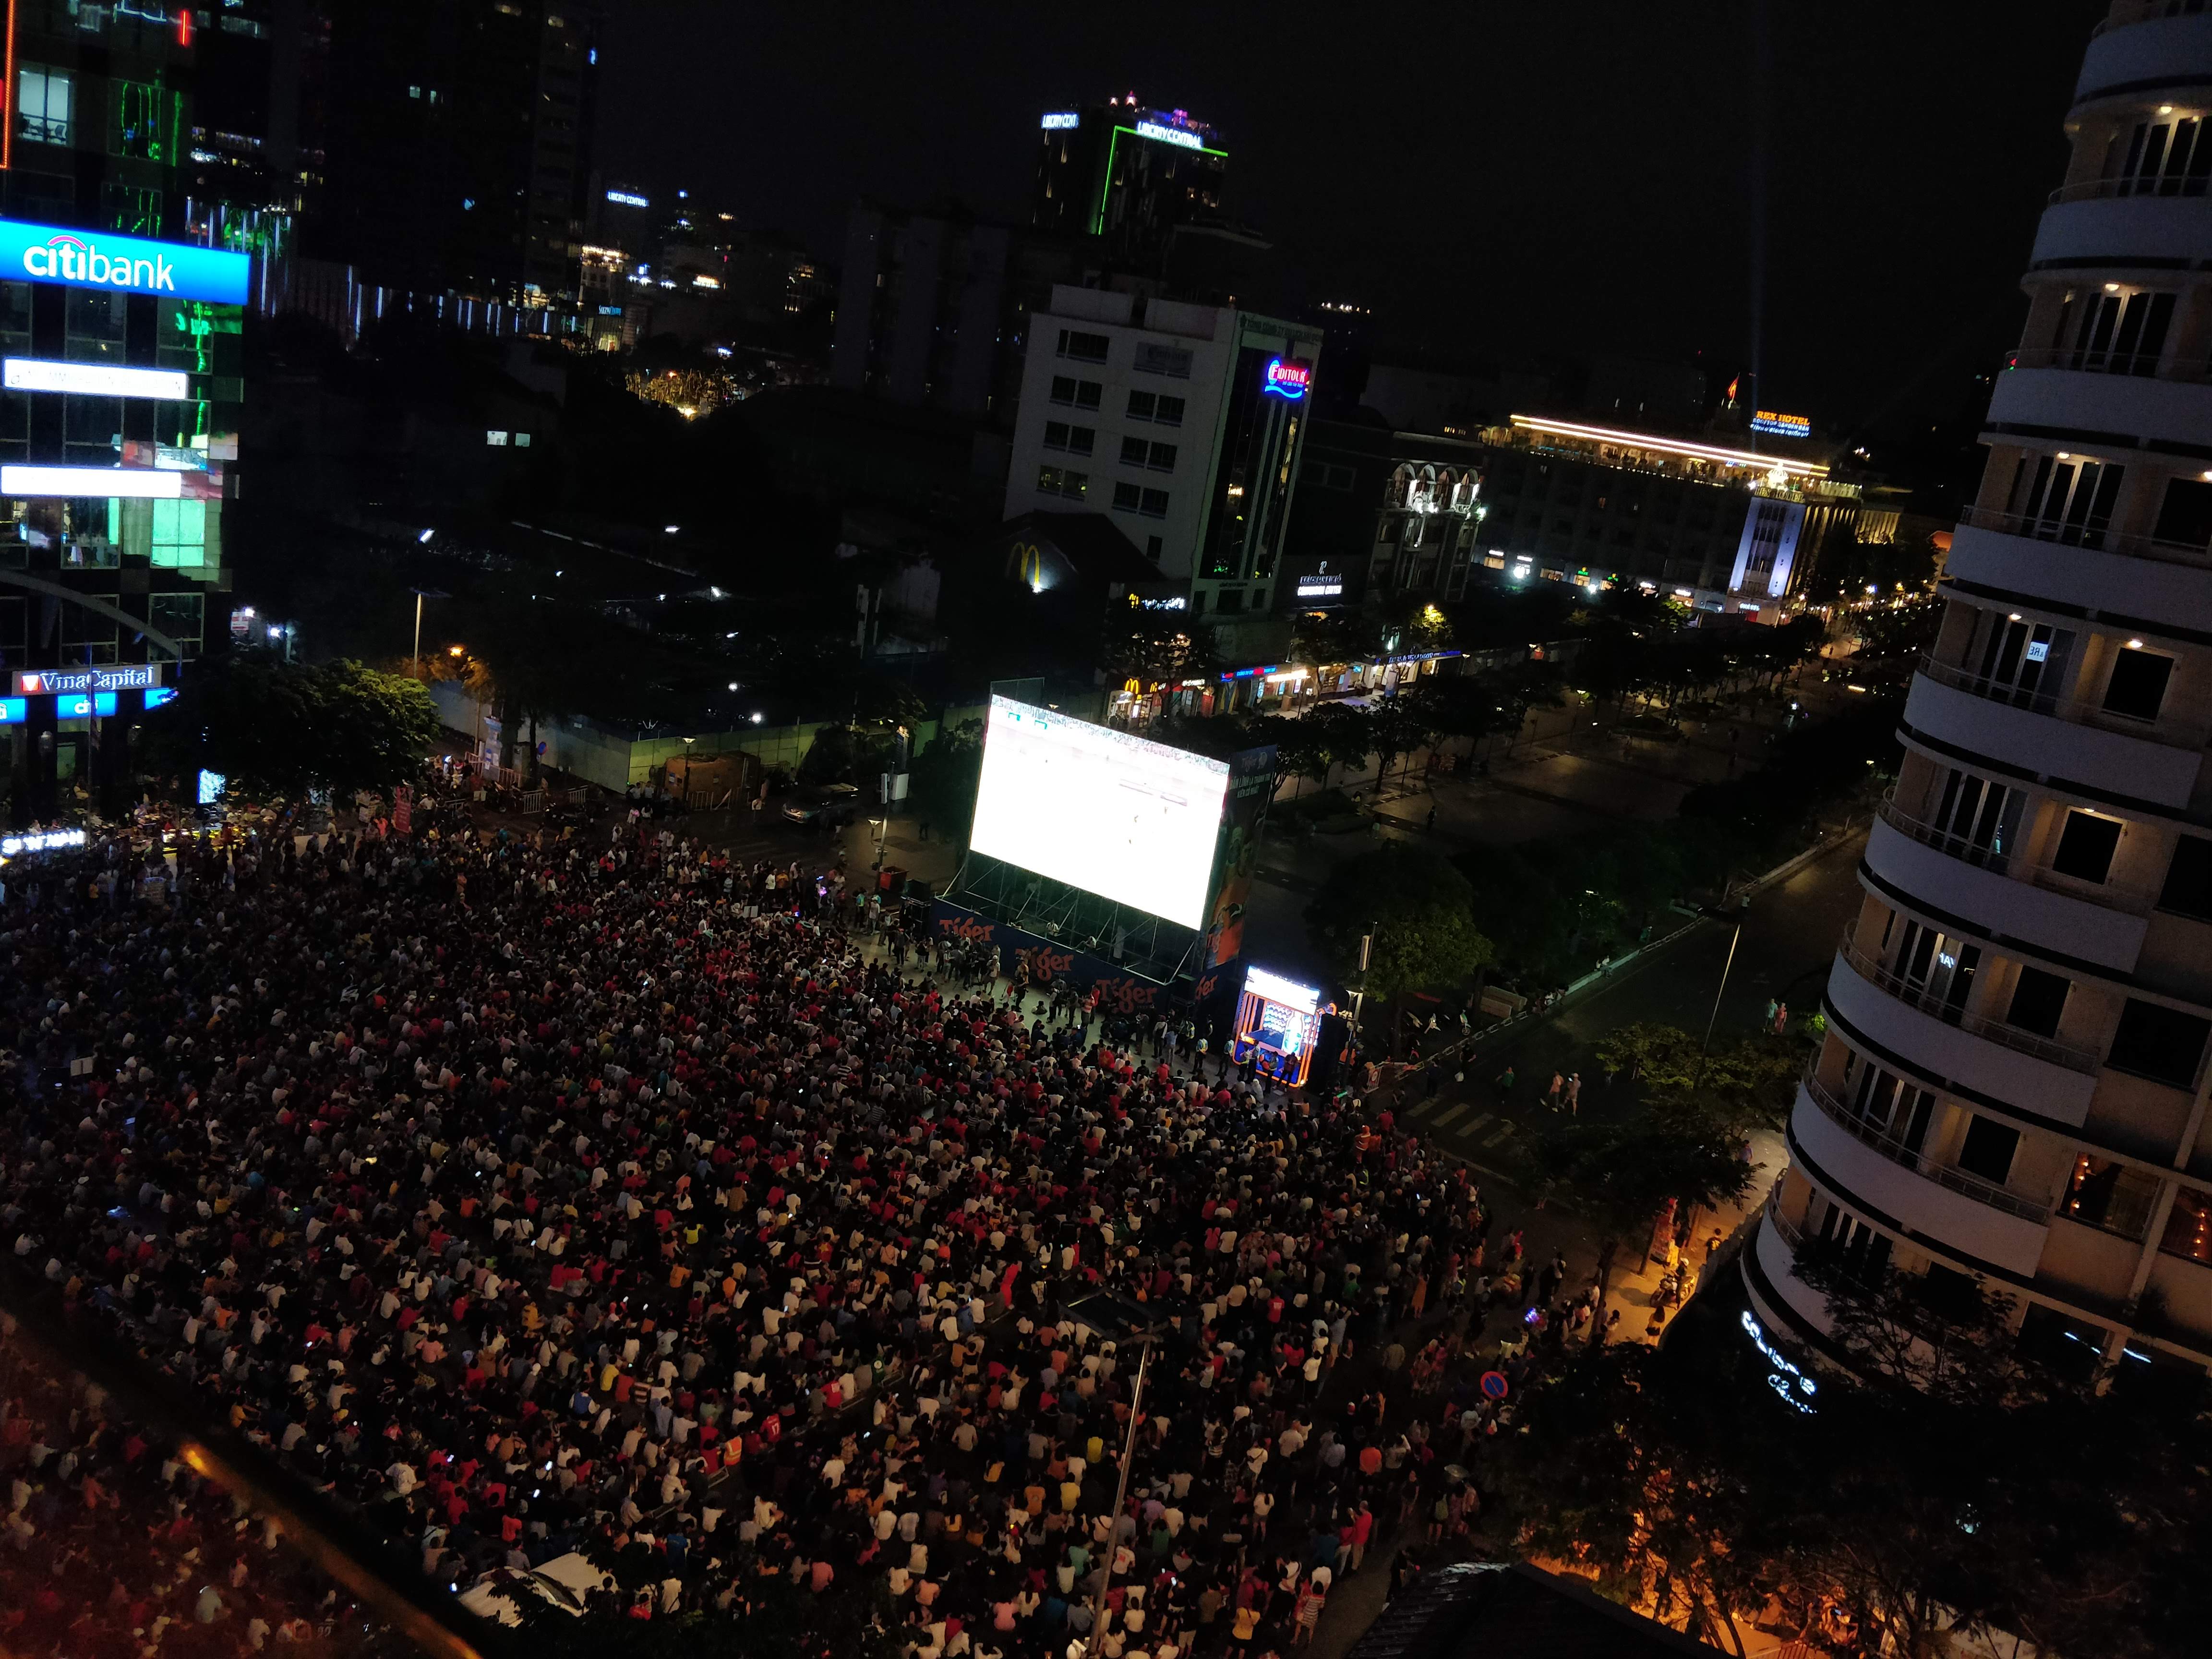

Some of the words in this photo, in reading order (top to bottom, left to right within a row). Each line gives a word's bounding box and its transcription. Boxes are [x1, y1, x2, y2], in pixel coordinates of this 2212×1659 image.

[1138, 121, 1168, 140] LIBERTY
[1167, 128, 1202, 149] CENTRAL
[23, 240, 175, 292] citibank
[1756, 410, 1777, 421] REX
[1778, 414, 1810, 426] HOTEL
[40, 666, 155, 691] VinaCapital
[939, 916, 995, 944] Tiger
[1095, 977, 1157, 1014] Tiger
